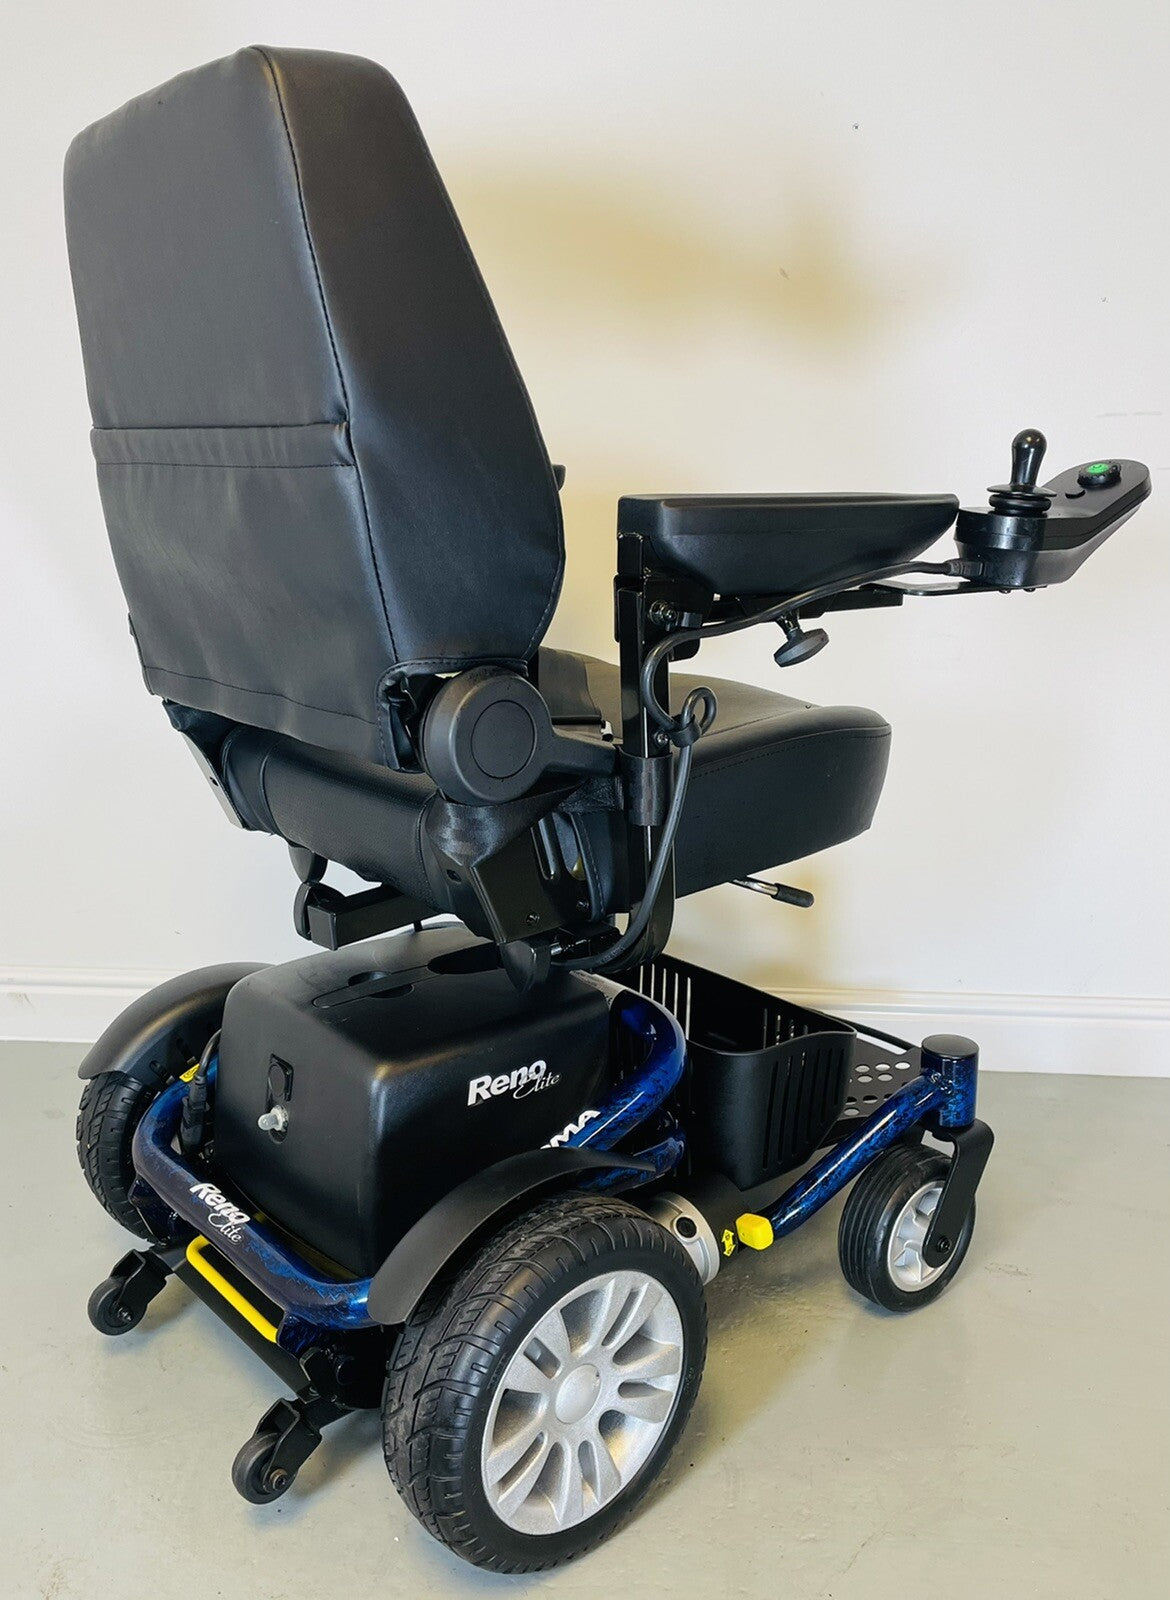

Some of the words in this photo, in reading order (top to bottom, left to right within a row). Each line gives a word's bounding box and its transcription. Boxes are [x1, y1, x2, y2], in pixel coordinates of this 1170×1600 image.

[467, 1060, 547, 1106] Reno
[513, 1072, 560, 1099] Elite
[540, 1110, 601, 1149] MA
[189, 1183, 251, 1225] Reno
[208, 1213, 242, 1243] Elite
